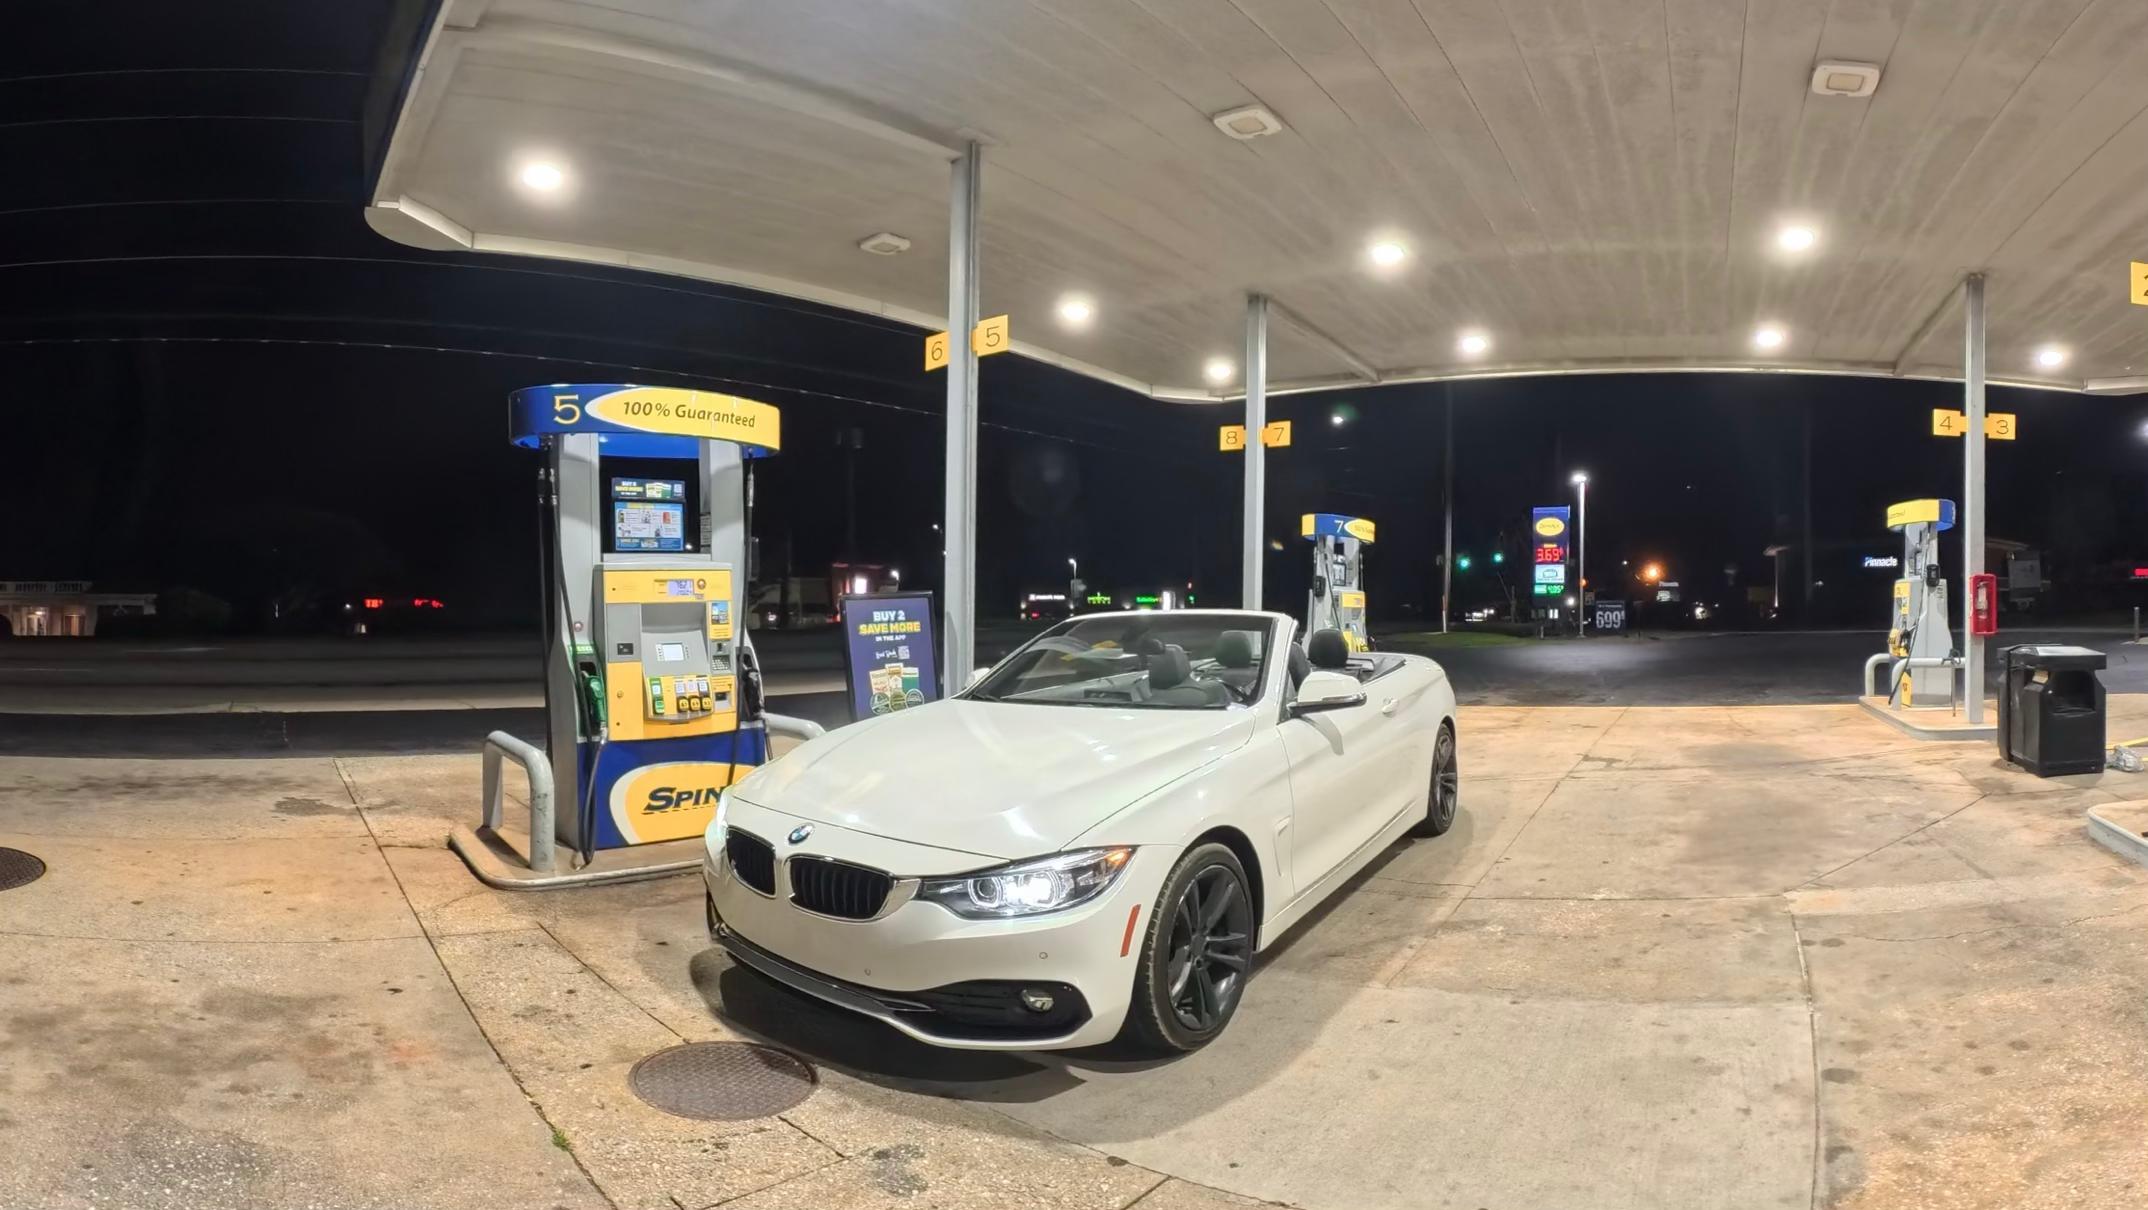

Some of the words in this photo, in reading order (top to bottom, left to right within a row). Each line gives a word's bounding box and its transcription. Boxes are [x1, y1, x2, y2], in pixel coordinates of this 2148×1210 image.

[985, 325, 1001, 348] 5
[931, 340, 943, 361] 6
[553, 394, 581, 425] 5
[623, 401, 671, 418] 100%
[675, 403, 756, 428] Guaranteed
[1939, 416, 1953, 431] 4
[1996, 419, 2009, 435] 3
[1225, 430, 1238, 445] 8
[1273, 427, 1285, 442] 7
[1334, 520, 1344, 533] 7
[1864, 556, 1898, 567] Pinnacle
[873, 611, 896, 621] BUY
[897, 609, 906, 620] 2
[859, 623, 888, 635] SAVE
[890, 622, 921, 633] MORE
[643, 785, 727, 811] SPIN
